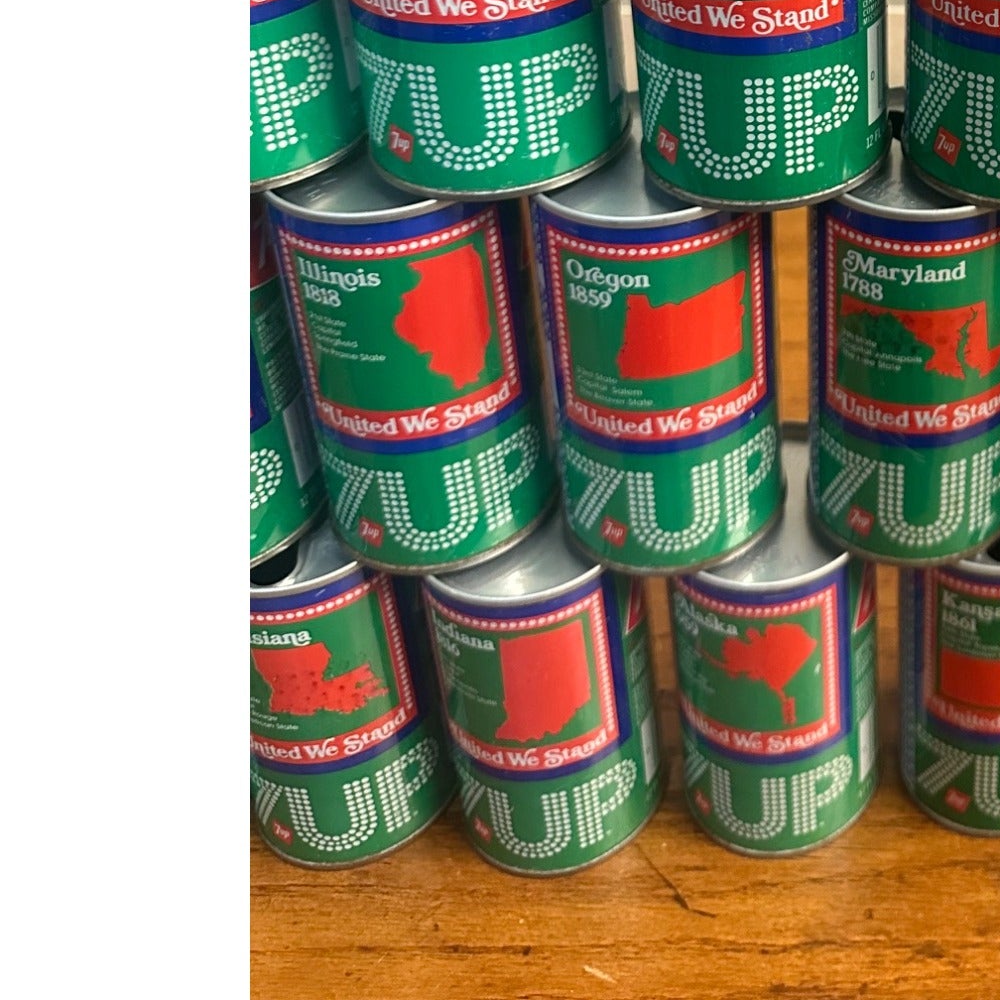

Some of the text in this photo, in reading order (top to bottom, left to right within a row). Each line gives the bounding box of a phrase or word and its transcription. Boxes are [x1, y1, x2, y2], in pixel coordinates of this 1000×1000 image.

[706, 1, 746, 29] We
[355, 40, 599, 173] 7UP
[637, 42, 860, 181] 7UP
[390, 129, 411, 151] 7up
[658, 131, 676, 152] 7up
[936, 133, 956, 153] 7up
[298, 256, 382, 292] Illinois
[565, 258, 652, 294] Oregon
[841, 250, 967, 287] Maryland
[841, 271, 884, 301] 1788
[302, 282, 342, 308] 1818
[568, 283, 612, 309] 1859
[359, 353, 387, 363] State
[320, 381, 511, 438] United We Stand
[573, 382, 759, 438] United We Stand
[628, 398, 654, 407] State
[833, 388, 910, 429] United
[914, 403, 948, 429] We
[317, 423, 541, 552] 7UP
[562, 423, 778, 554] 7UP
[360, 519, 381, 540] 7up
[942, 611, 978, 632] 1861
[303, 707, 407, 760] We Stand
[507, 730, 608, 769] We Stand
[733, 722, 829, 756] We Stand
